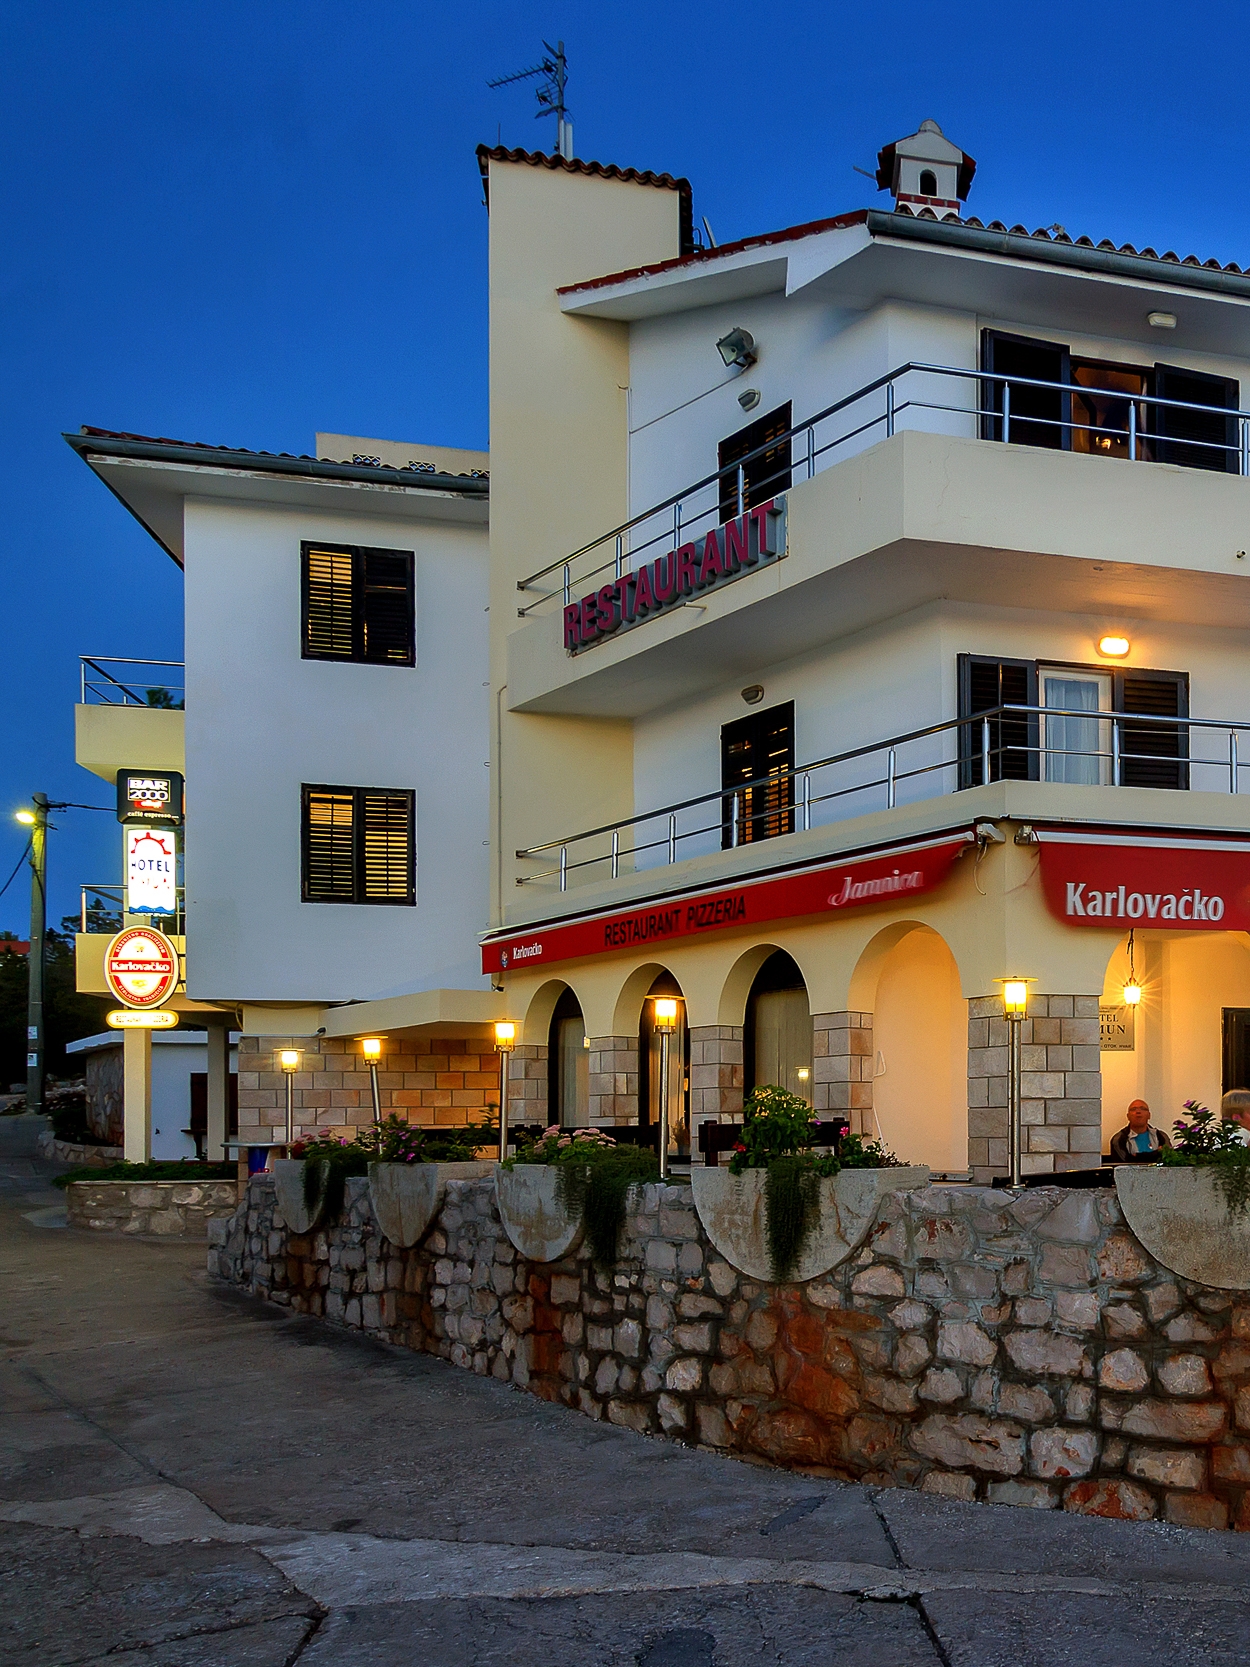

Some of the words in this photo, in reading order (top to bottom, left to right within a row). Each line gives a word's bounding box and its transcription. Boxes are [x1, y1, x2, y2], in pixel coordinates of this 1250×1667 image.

[563, 498, 781, 651] RESTAURANT
[129, 779, 168, 790] BAR
[129, 789, 168, 800] 2000
[1065, 882, 1225, 921] Karlovačko
[604, 909, 681, 947] RESTAURANT
[686, 895, 746, 930] PIZZERIA
[513, 942, 543, 960] Karlovačko
[111, 961, 170, 972] Karlovačko
